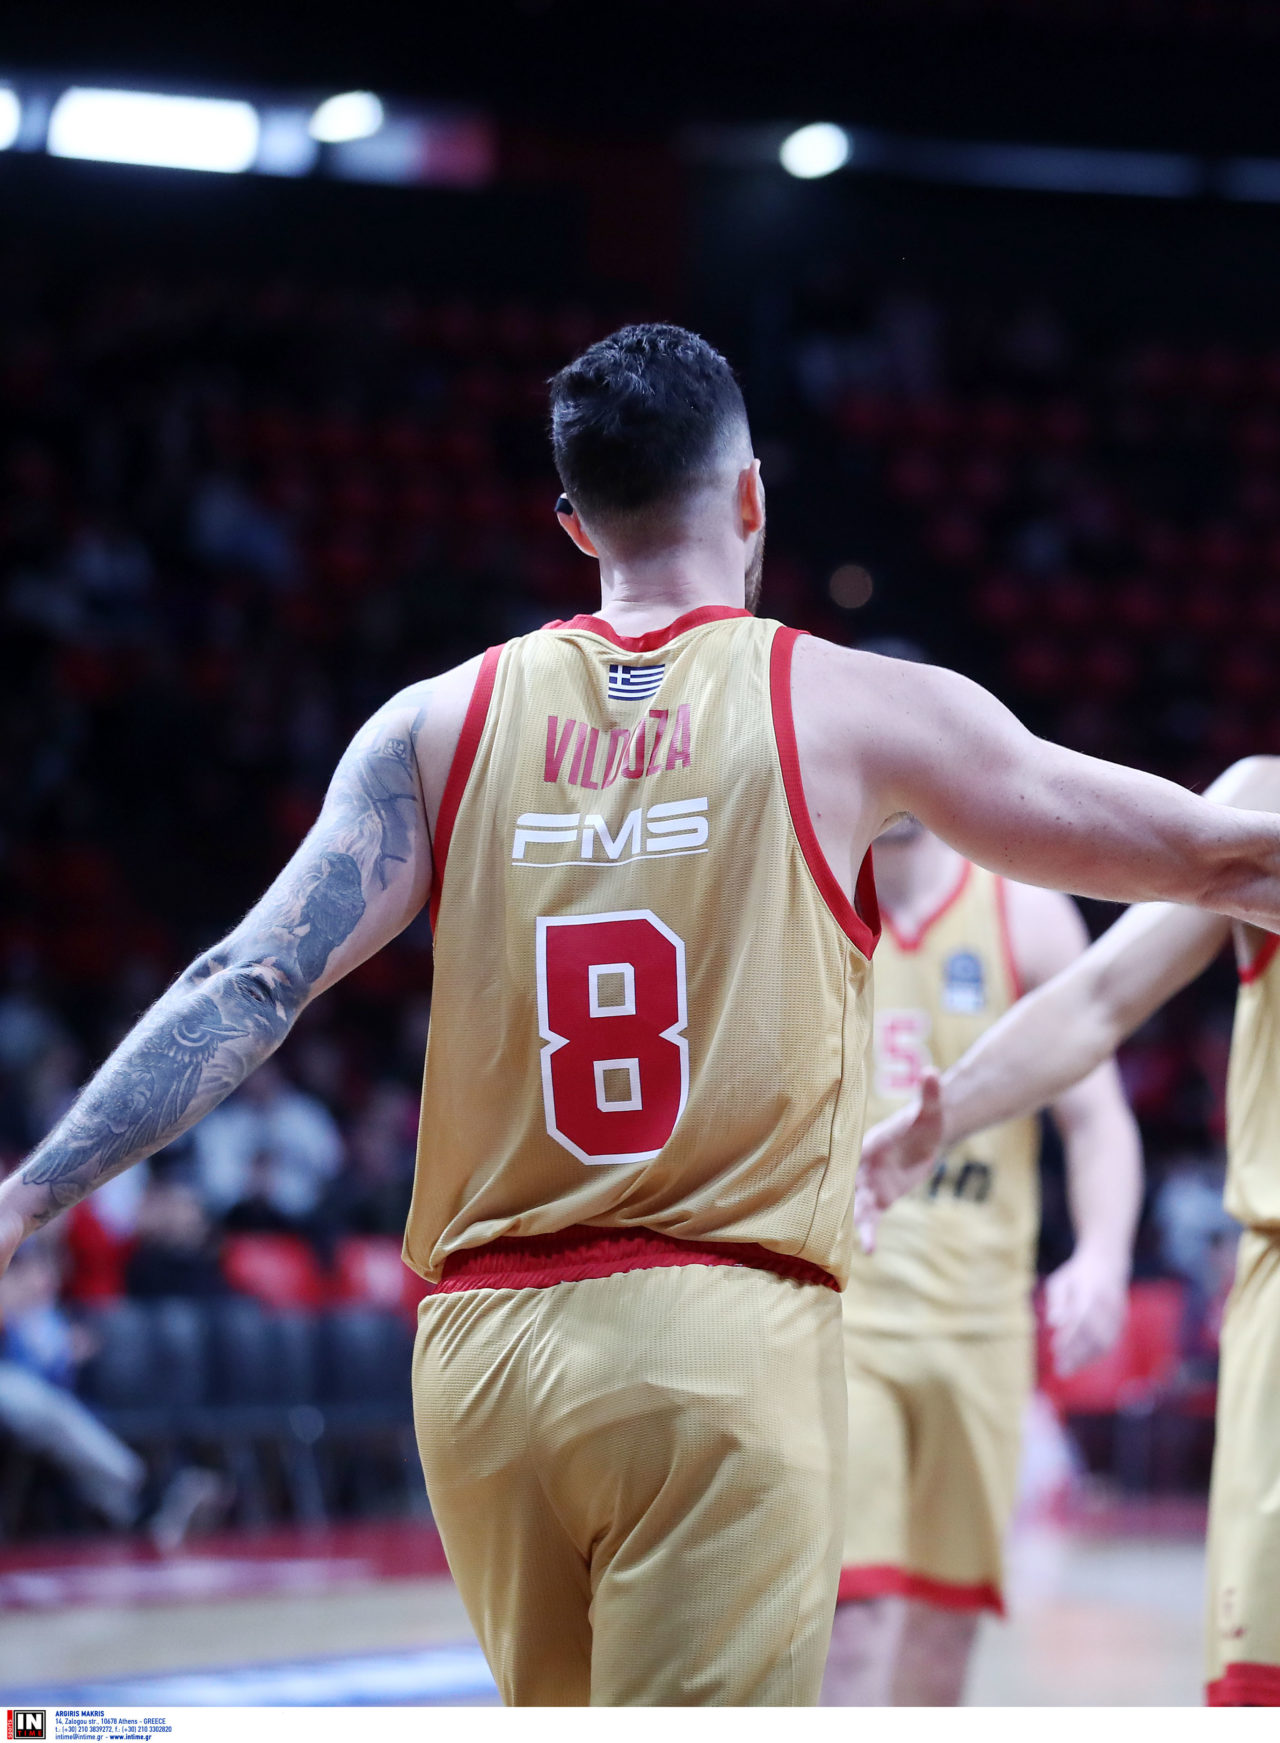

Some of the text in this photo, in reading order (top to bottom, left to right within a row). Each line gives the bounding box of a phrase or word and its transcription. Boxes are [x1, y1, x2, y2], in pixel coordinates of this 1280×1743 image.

[544, 703, 692, 790] VILDOZA
[511, 797, 709, 859] FMS
[535, 909, 689, 1166] 8
